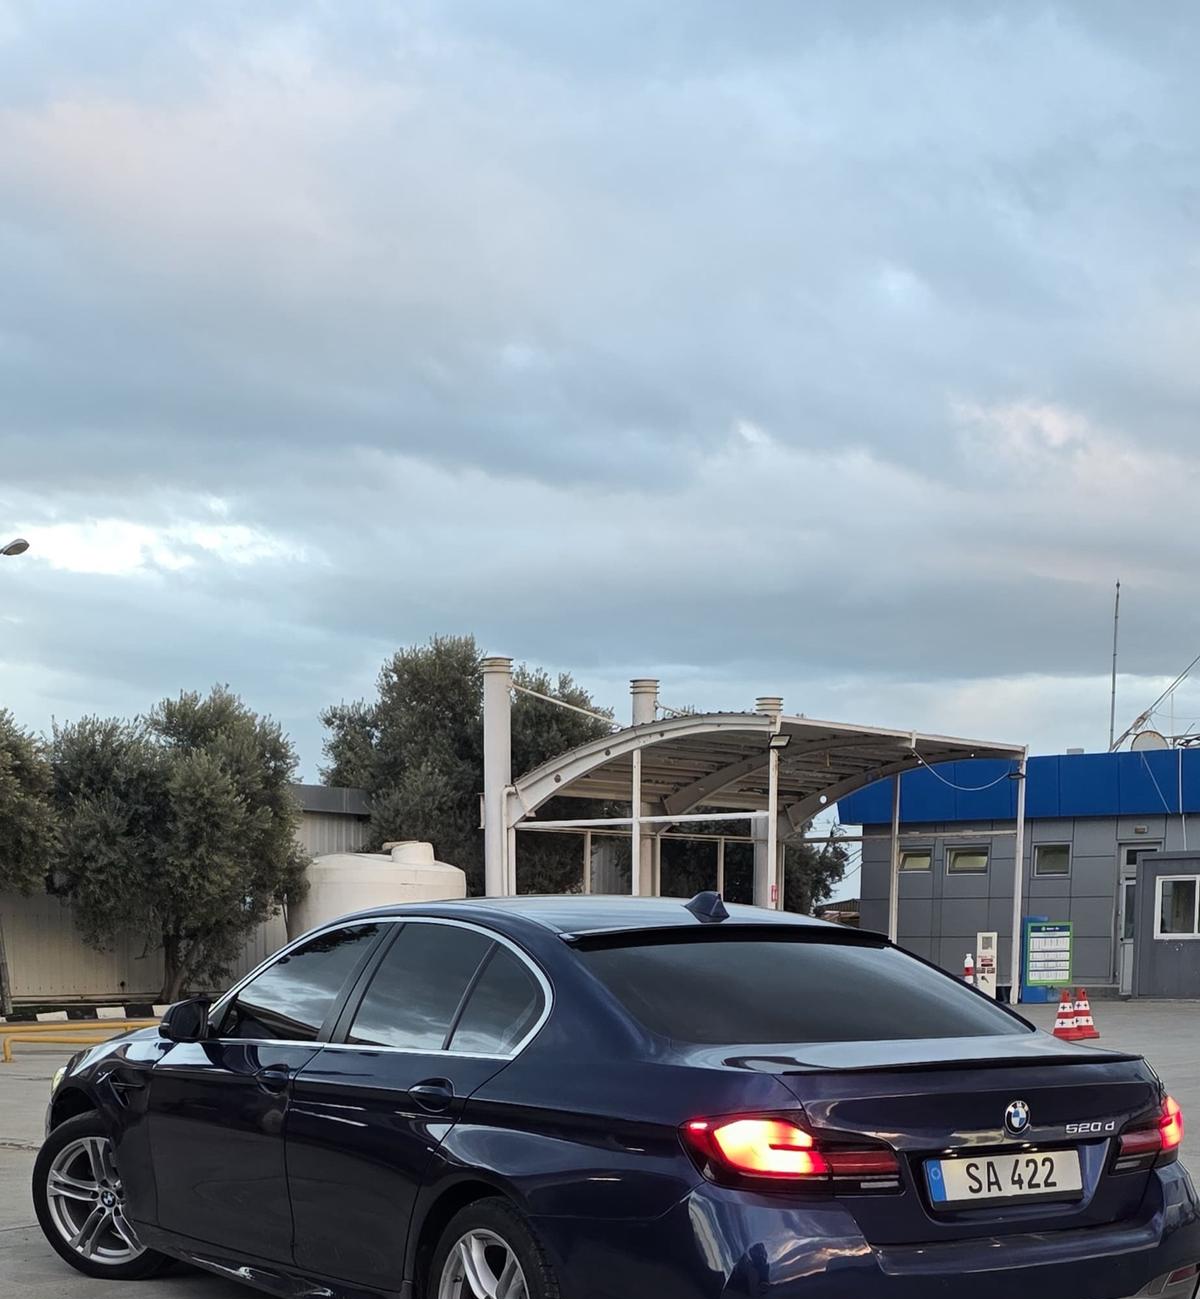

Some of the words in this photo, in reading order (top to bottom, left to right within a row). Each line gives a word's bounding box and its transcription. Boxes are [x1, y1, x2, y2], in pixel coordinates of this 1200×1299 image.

[1065, 1123, 1103, 1134] 520
[1105, 1121, 1115, 1132] d
[966, 1161, 1003, 1194] SA
[1011, 1157, 1057, 1190] 422
